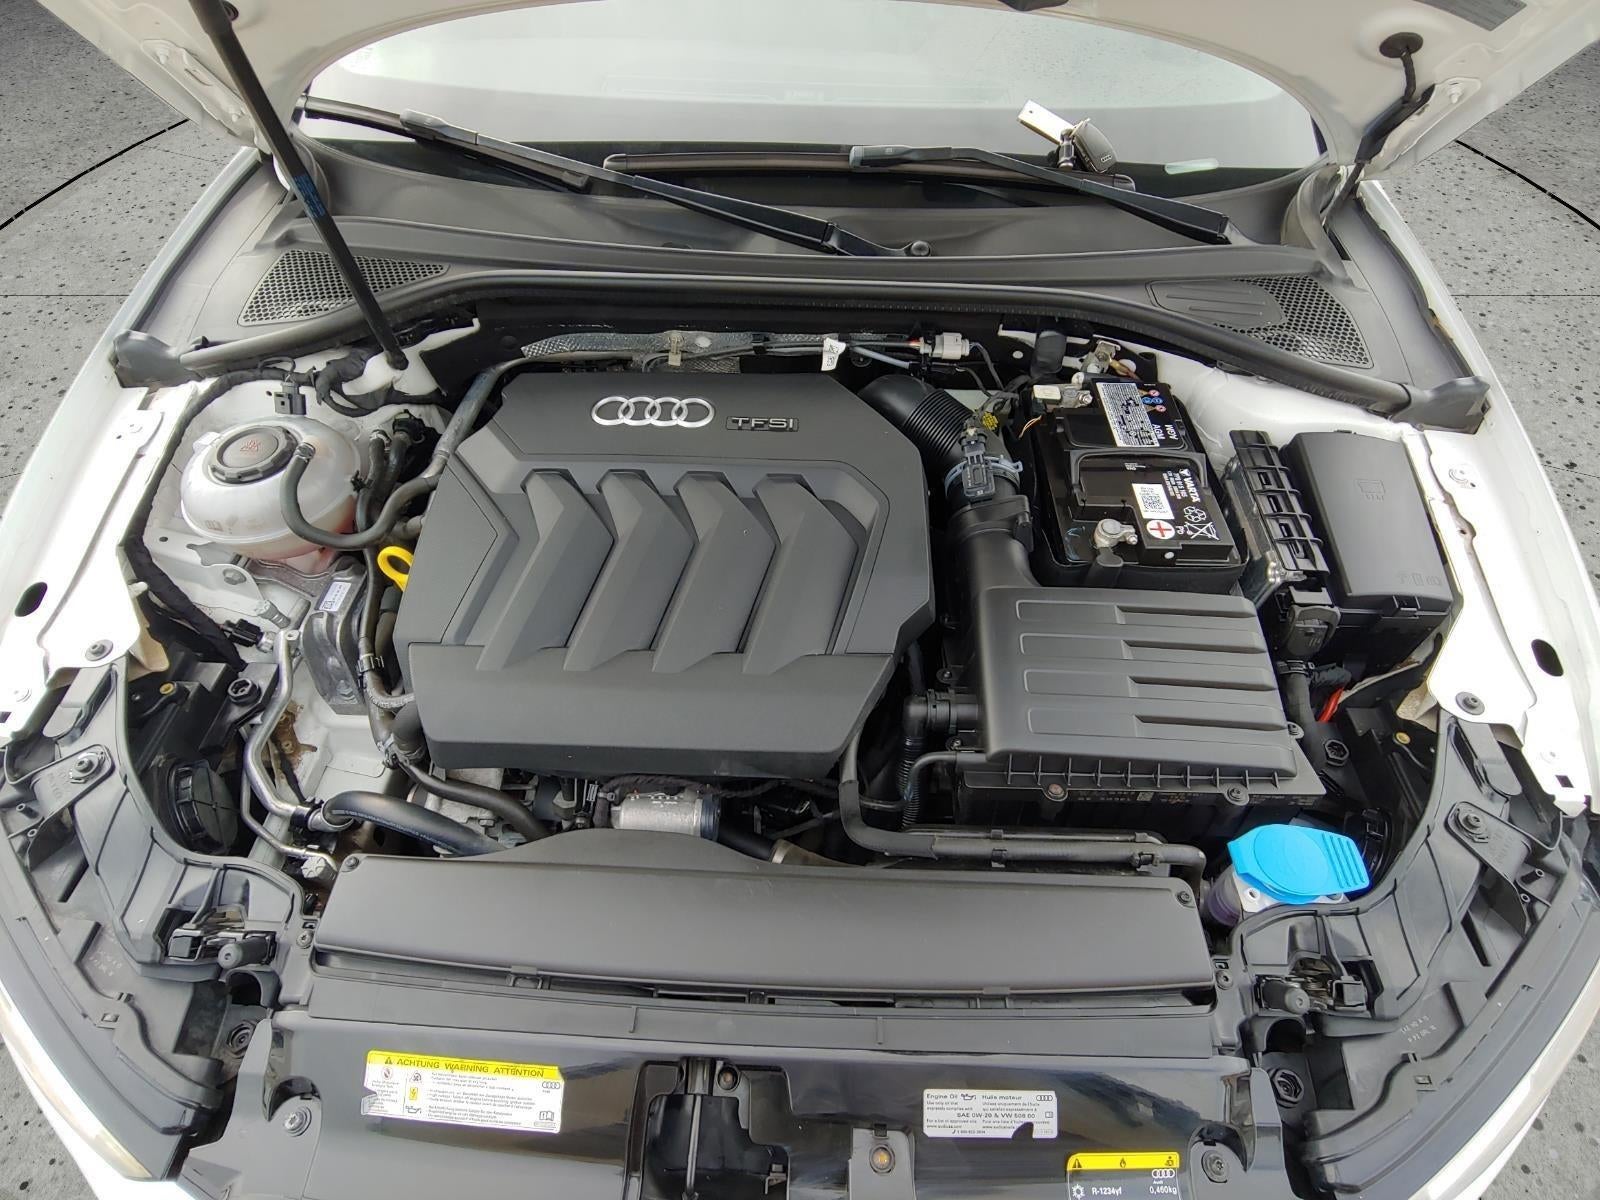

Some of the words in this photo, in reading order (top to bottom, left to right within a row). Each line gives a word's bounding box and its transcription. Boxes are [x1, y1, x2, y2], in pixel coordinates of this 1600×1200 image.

[731, 417, 794, 429] TFSI
[1152, 424, 1166, 440] AGM
[1184, 477, 1200, 503] VARTA
[396, 1058, 440, 1069] ACHTUNG
[444, 1063, 489, 1074] WARNING
[493, 1067, 544, 1078] ATTENTION
[1091, 1186, 1122, 1196] R-1234yf
